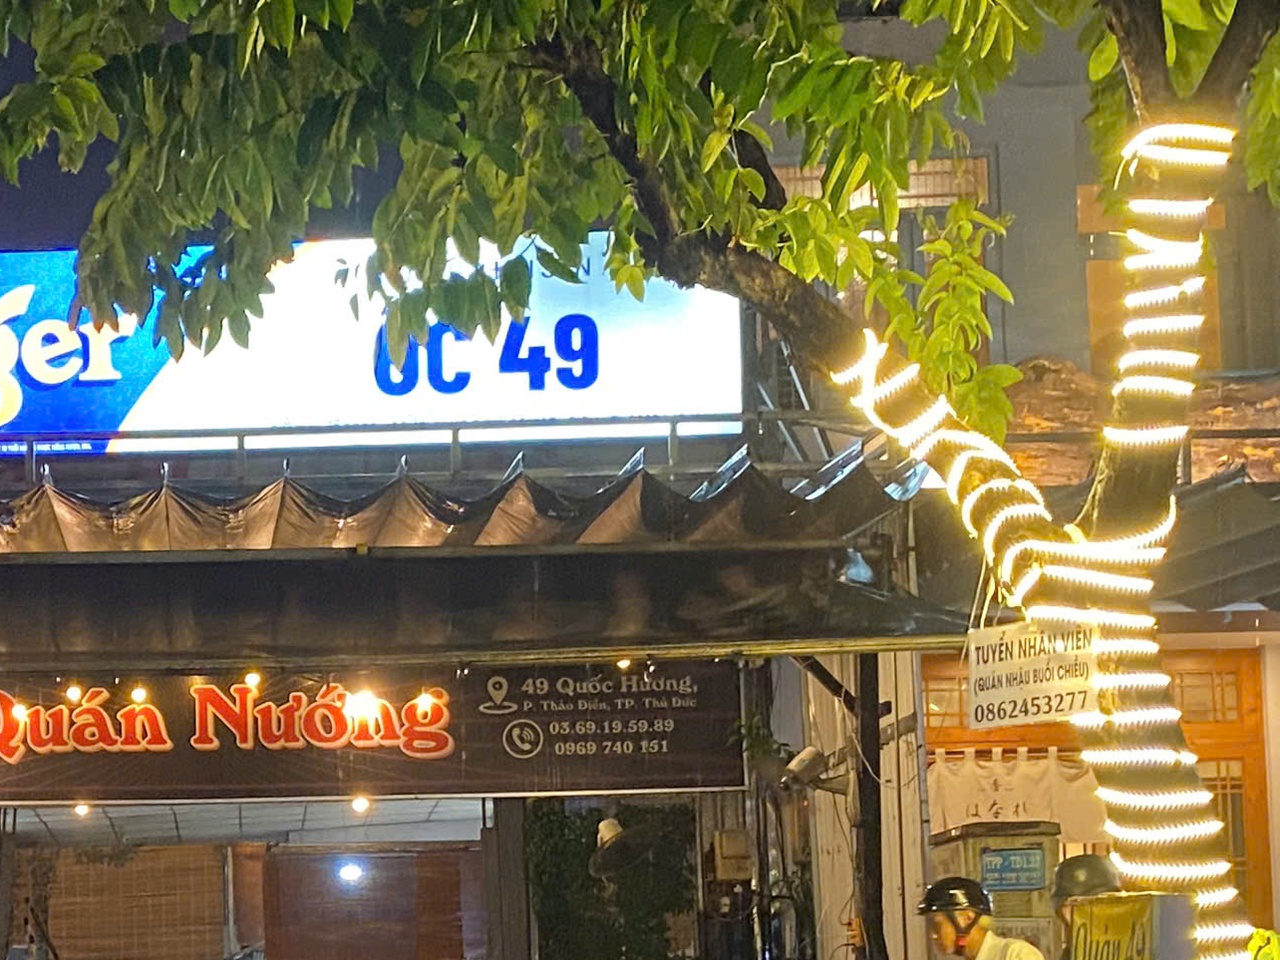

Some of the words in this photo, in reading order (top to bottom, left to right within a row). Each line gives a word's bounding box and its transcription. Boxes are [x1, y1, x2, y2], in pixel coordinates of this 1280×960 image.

[499, 313, 599, 391] 49
[975, 631, 1014, 665] TUYỂN
[1018, 630, 1057, 659] NHÂN
[1061, 625, 1093, 652] VIÊN
[521, 678, 549, 695] 49
[556, 674, 613, 696] Quốc
[620, 674, 698, 695] Hương,
[190, 683, 455, 760] Nướng
[975, 690, 1088, 723] 0862453277
[549, 719, 675, 735] 03.69.19.59.89
[602, 741, 633, 755] 740
